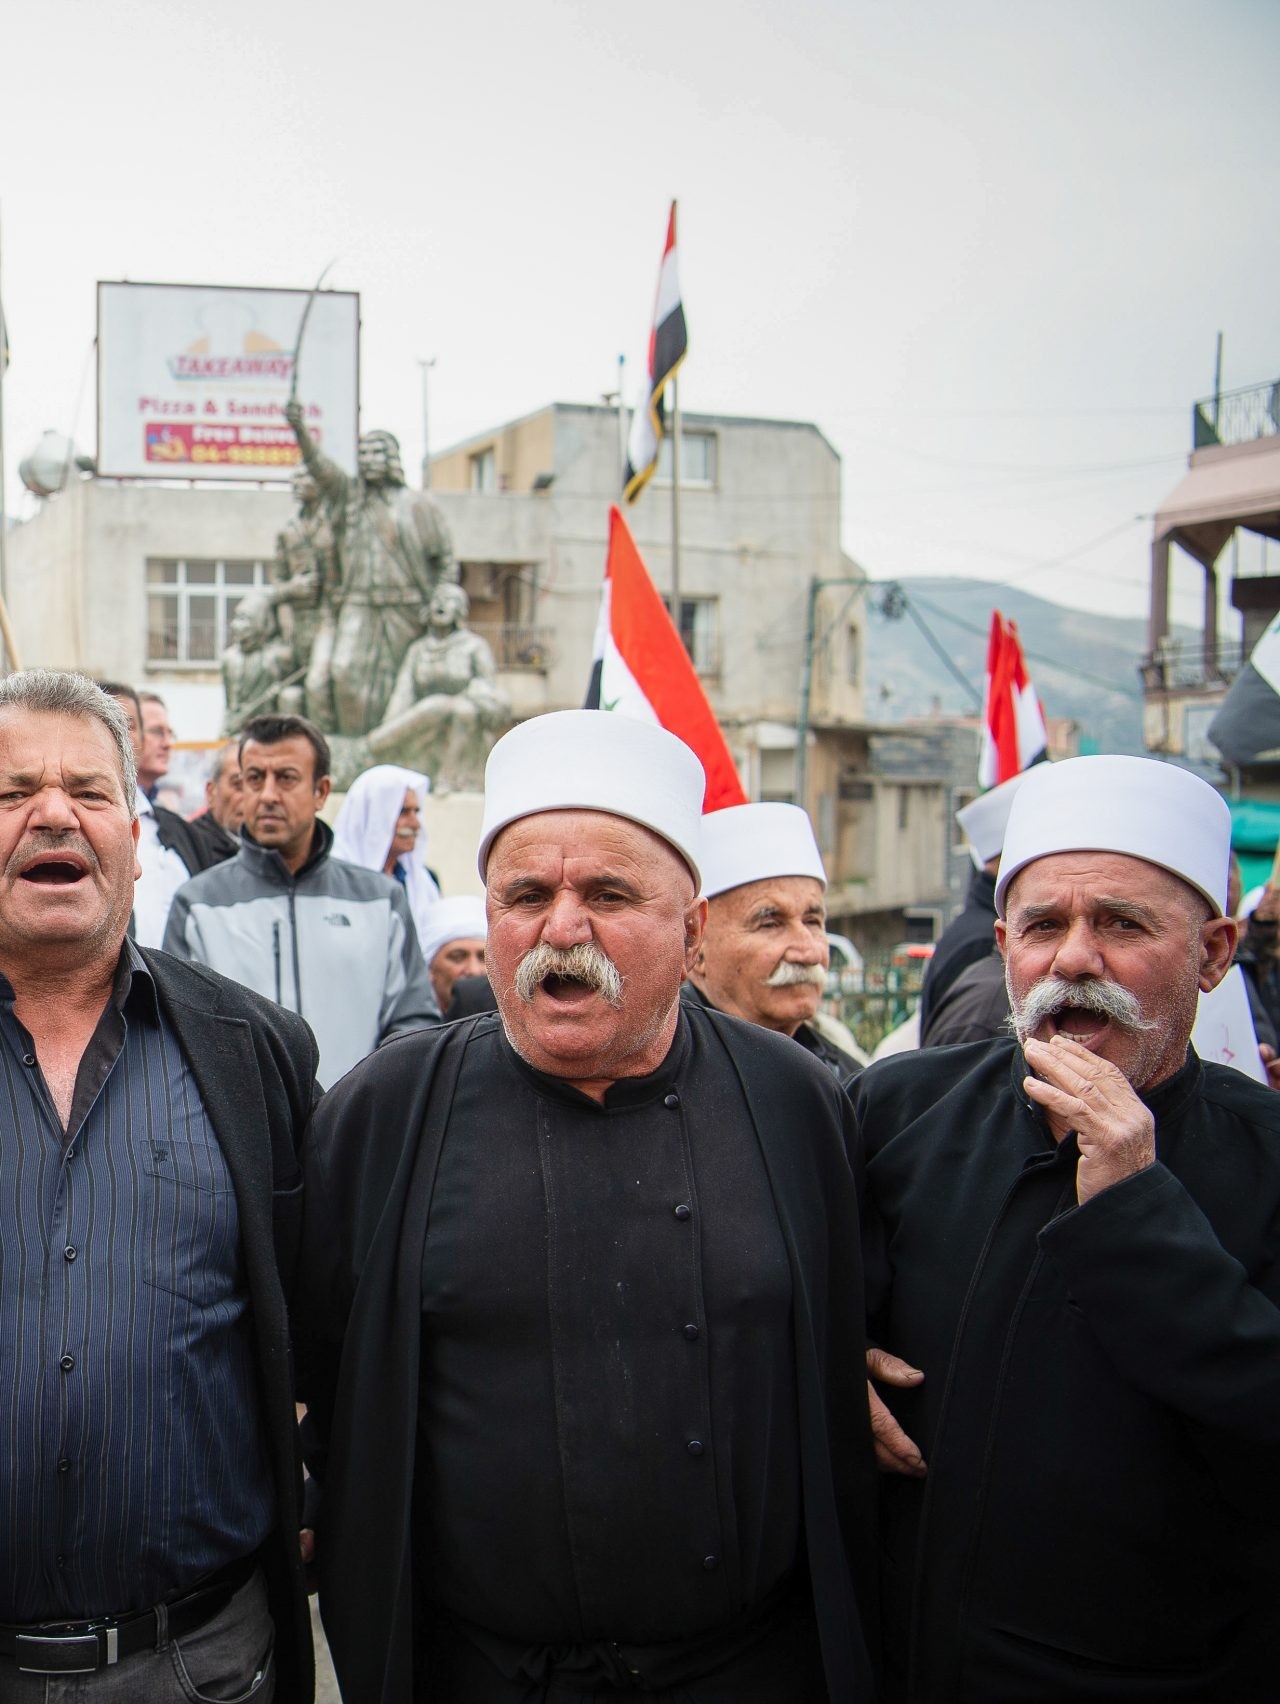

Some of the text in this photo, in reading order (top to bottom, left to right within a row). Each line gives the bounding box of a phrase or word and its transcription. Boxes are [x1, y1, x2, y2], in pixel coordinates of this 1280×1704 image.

[177, 356, 293, 378] TAKEAWAY
[138, 398, 322, 418] Pizza & Sandwh
[192, 425, 236, 443] Free
